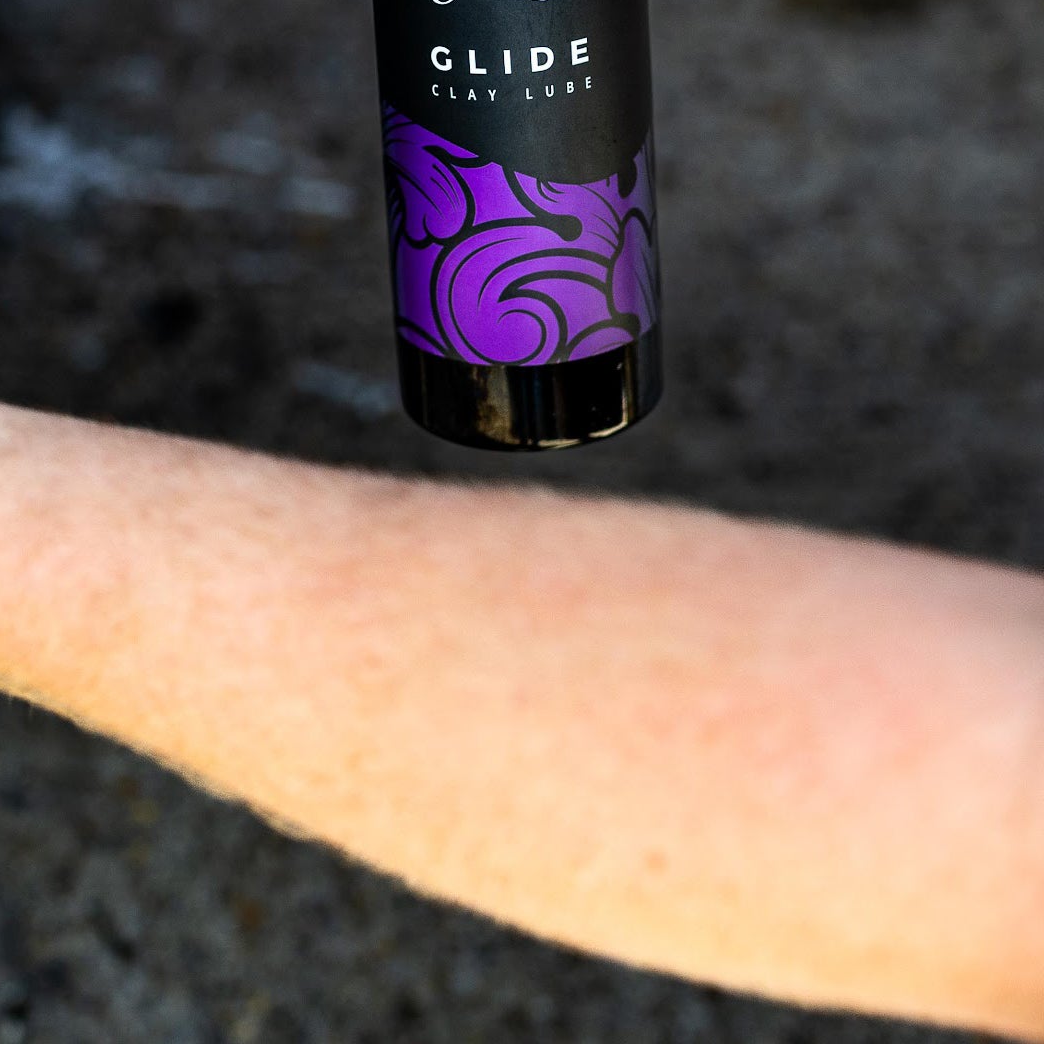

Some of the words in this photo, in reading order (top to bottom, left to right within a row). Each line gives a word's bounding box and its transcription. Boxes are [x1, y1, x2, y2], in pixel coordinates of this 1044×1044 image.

[430, 37, 590, 75] GLIDE
[431, 83, 497, 102] CLAY
[525, 75, 592, 100] LUBE
